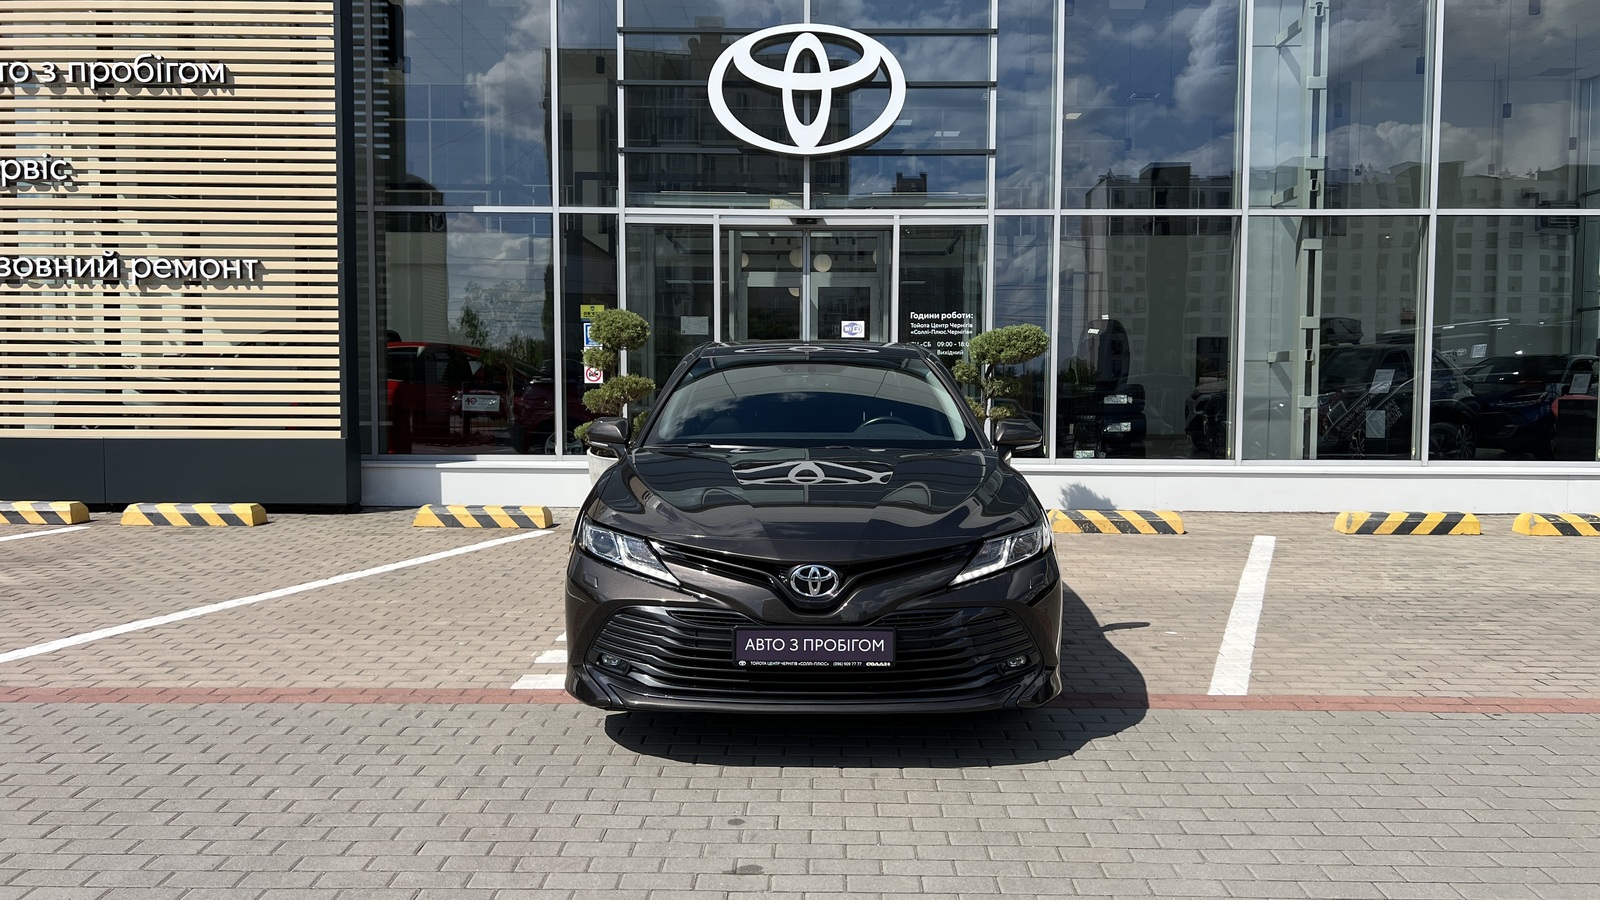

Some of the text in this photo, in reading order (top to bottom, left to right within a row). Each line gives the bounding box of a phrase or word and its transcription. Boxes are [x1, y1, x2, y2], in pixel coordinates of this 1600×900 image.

[40, 61, 57, 83] з
[68, 53, 227, 89] пробігом
[1, 152, 68, 187] рвіс
[0, 251, 259, 284] зовний ремонт
[910, 311, 974, 321] Години роботи:
[744, 638, 886, 652] АВТО З ПРОБІГОМ
